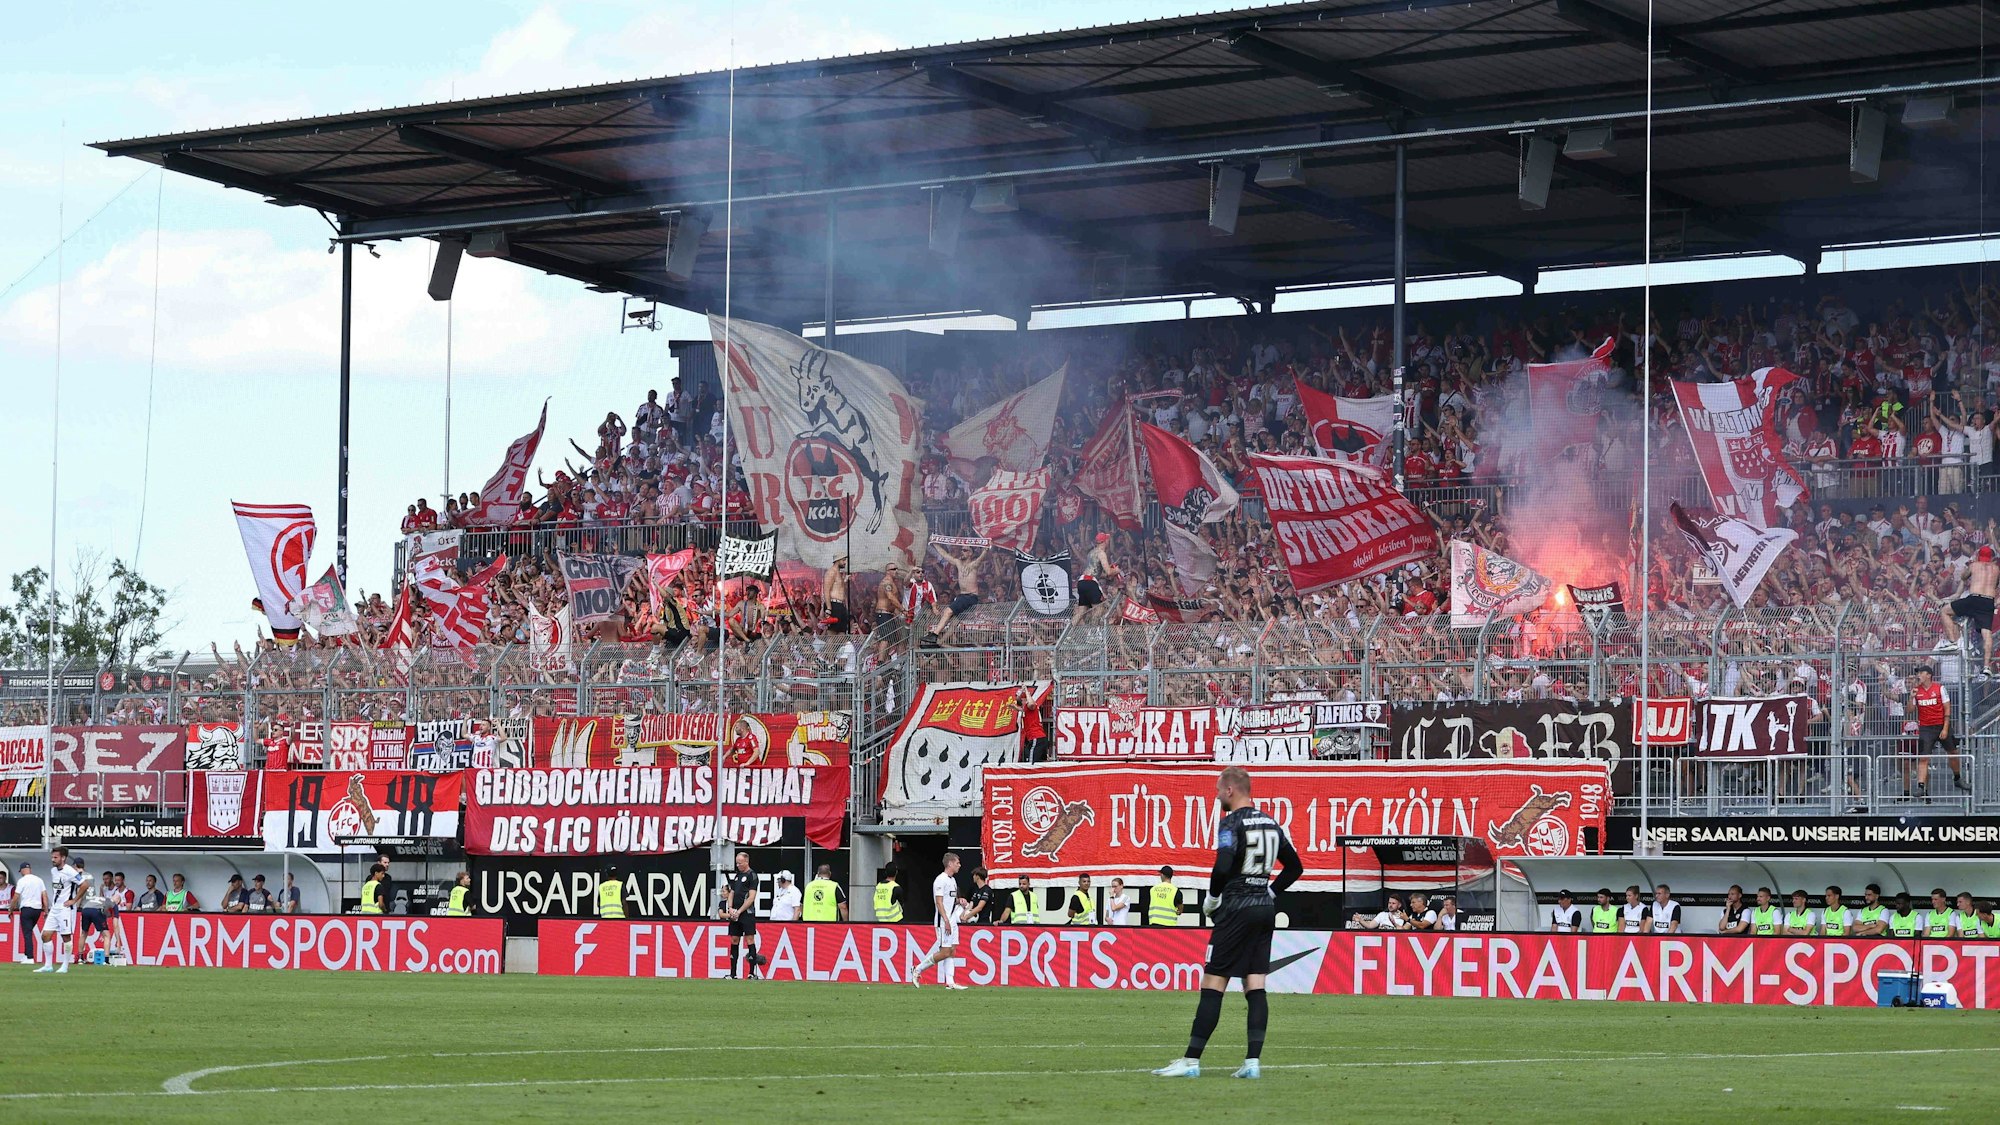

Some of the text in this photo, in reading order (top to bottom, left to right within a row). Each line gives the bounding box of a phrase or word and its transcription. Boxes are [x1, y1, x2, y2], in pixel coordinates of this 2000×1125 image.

[1276, 499, 1425, 567] SYNDIKAT
[64, 678, 94, 687] EXPRESS
[1918, 698, 1938, 706] REWE
[1316, 705, 1363, 724] RAFIKIS
[331, 726, 370, 750] SPS
[807, 722, 837, 742] Horde
[63, 783, 152, 801] CREW
[665, 766, 713, 804] ALS
[721, 767, 815, 804] HEIMAT
[285, 775, 326, 848] 19
[1580, 783, 1604, 820] 1948
[990, 785, 1014, 864] 1.FC KÖLN
[1109, 784, 1177, 850] FÜR
[1306, 797, 1373, 853] 1.FC
[41, 825, 183, 838] UNSER SAARLAND. UNSERE
[489, 815, 539, 853] DES
[543, 815, 592, 854] 1.FC
[597, 810, 660, 853] KÖLN
[1632, 826, 1688, 842] UNSER
[1691, 826, 1788, 842] SAARLAND.
[1792, 826, 1861, 842] UNSERE
[1865, 826, 1934, 842] HEIMAT.
[1241, 829, 1280, 875] 20
[1403, 850, 1465, 861] DECKERT
[1460, 923, 1495, 931] DECKERT
